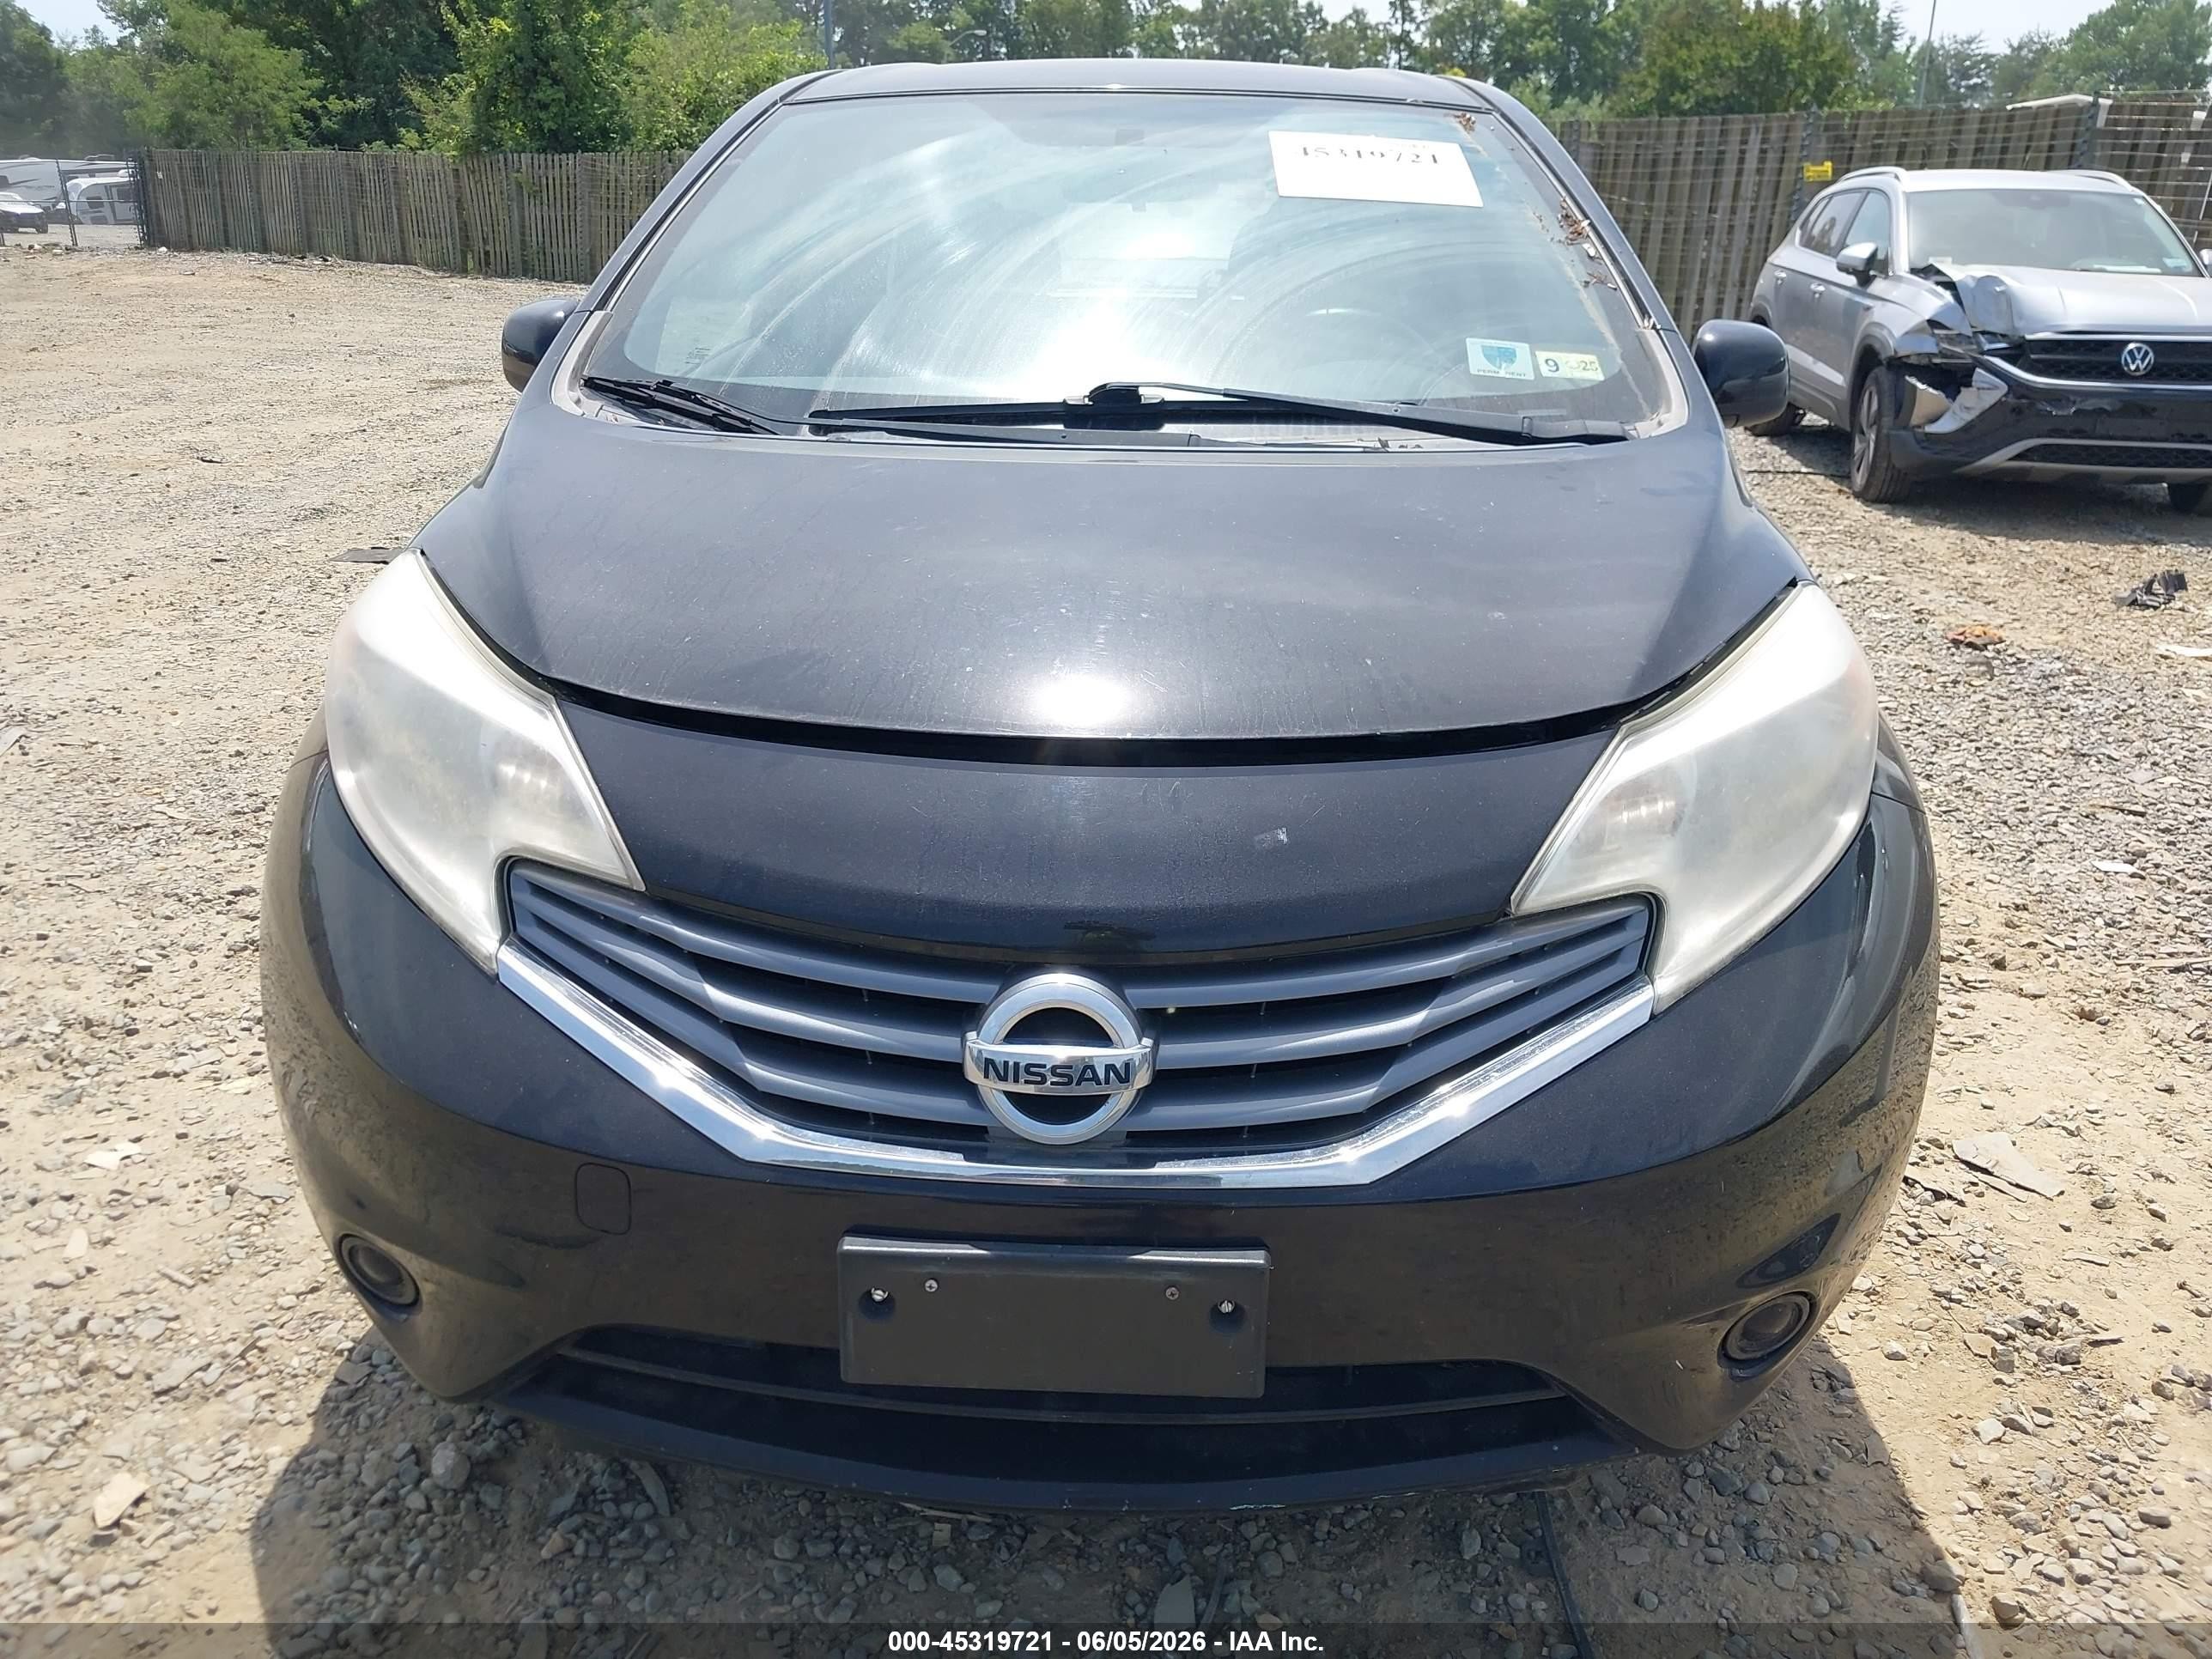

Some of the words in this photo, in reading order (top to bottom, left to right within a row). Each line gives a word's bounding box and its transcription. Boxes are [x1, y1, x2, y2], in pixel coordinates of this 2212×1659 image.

[1477, 368, 1526, 377] PERMNENT
[1544, 357, 1560, 374] 9
[982, 1057, 1132, 1087] NISSAN
